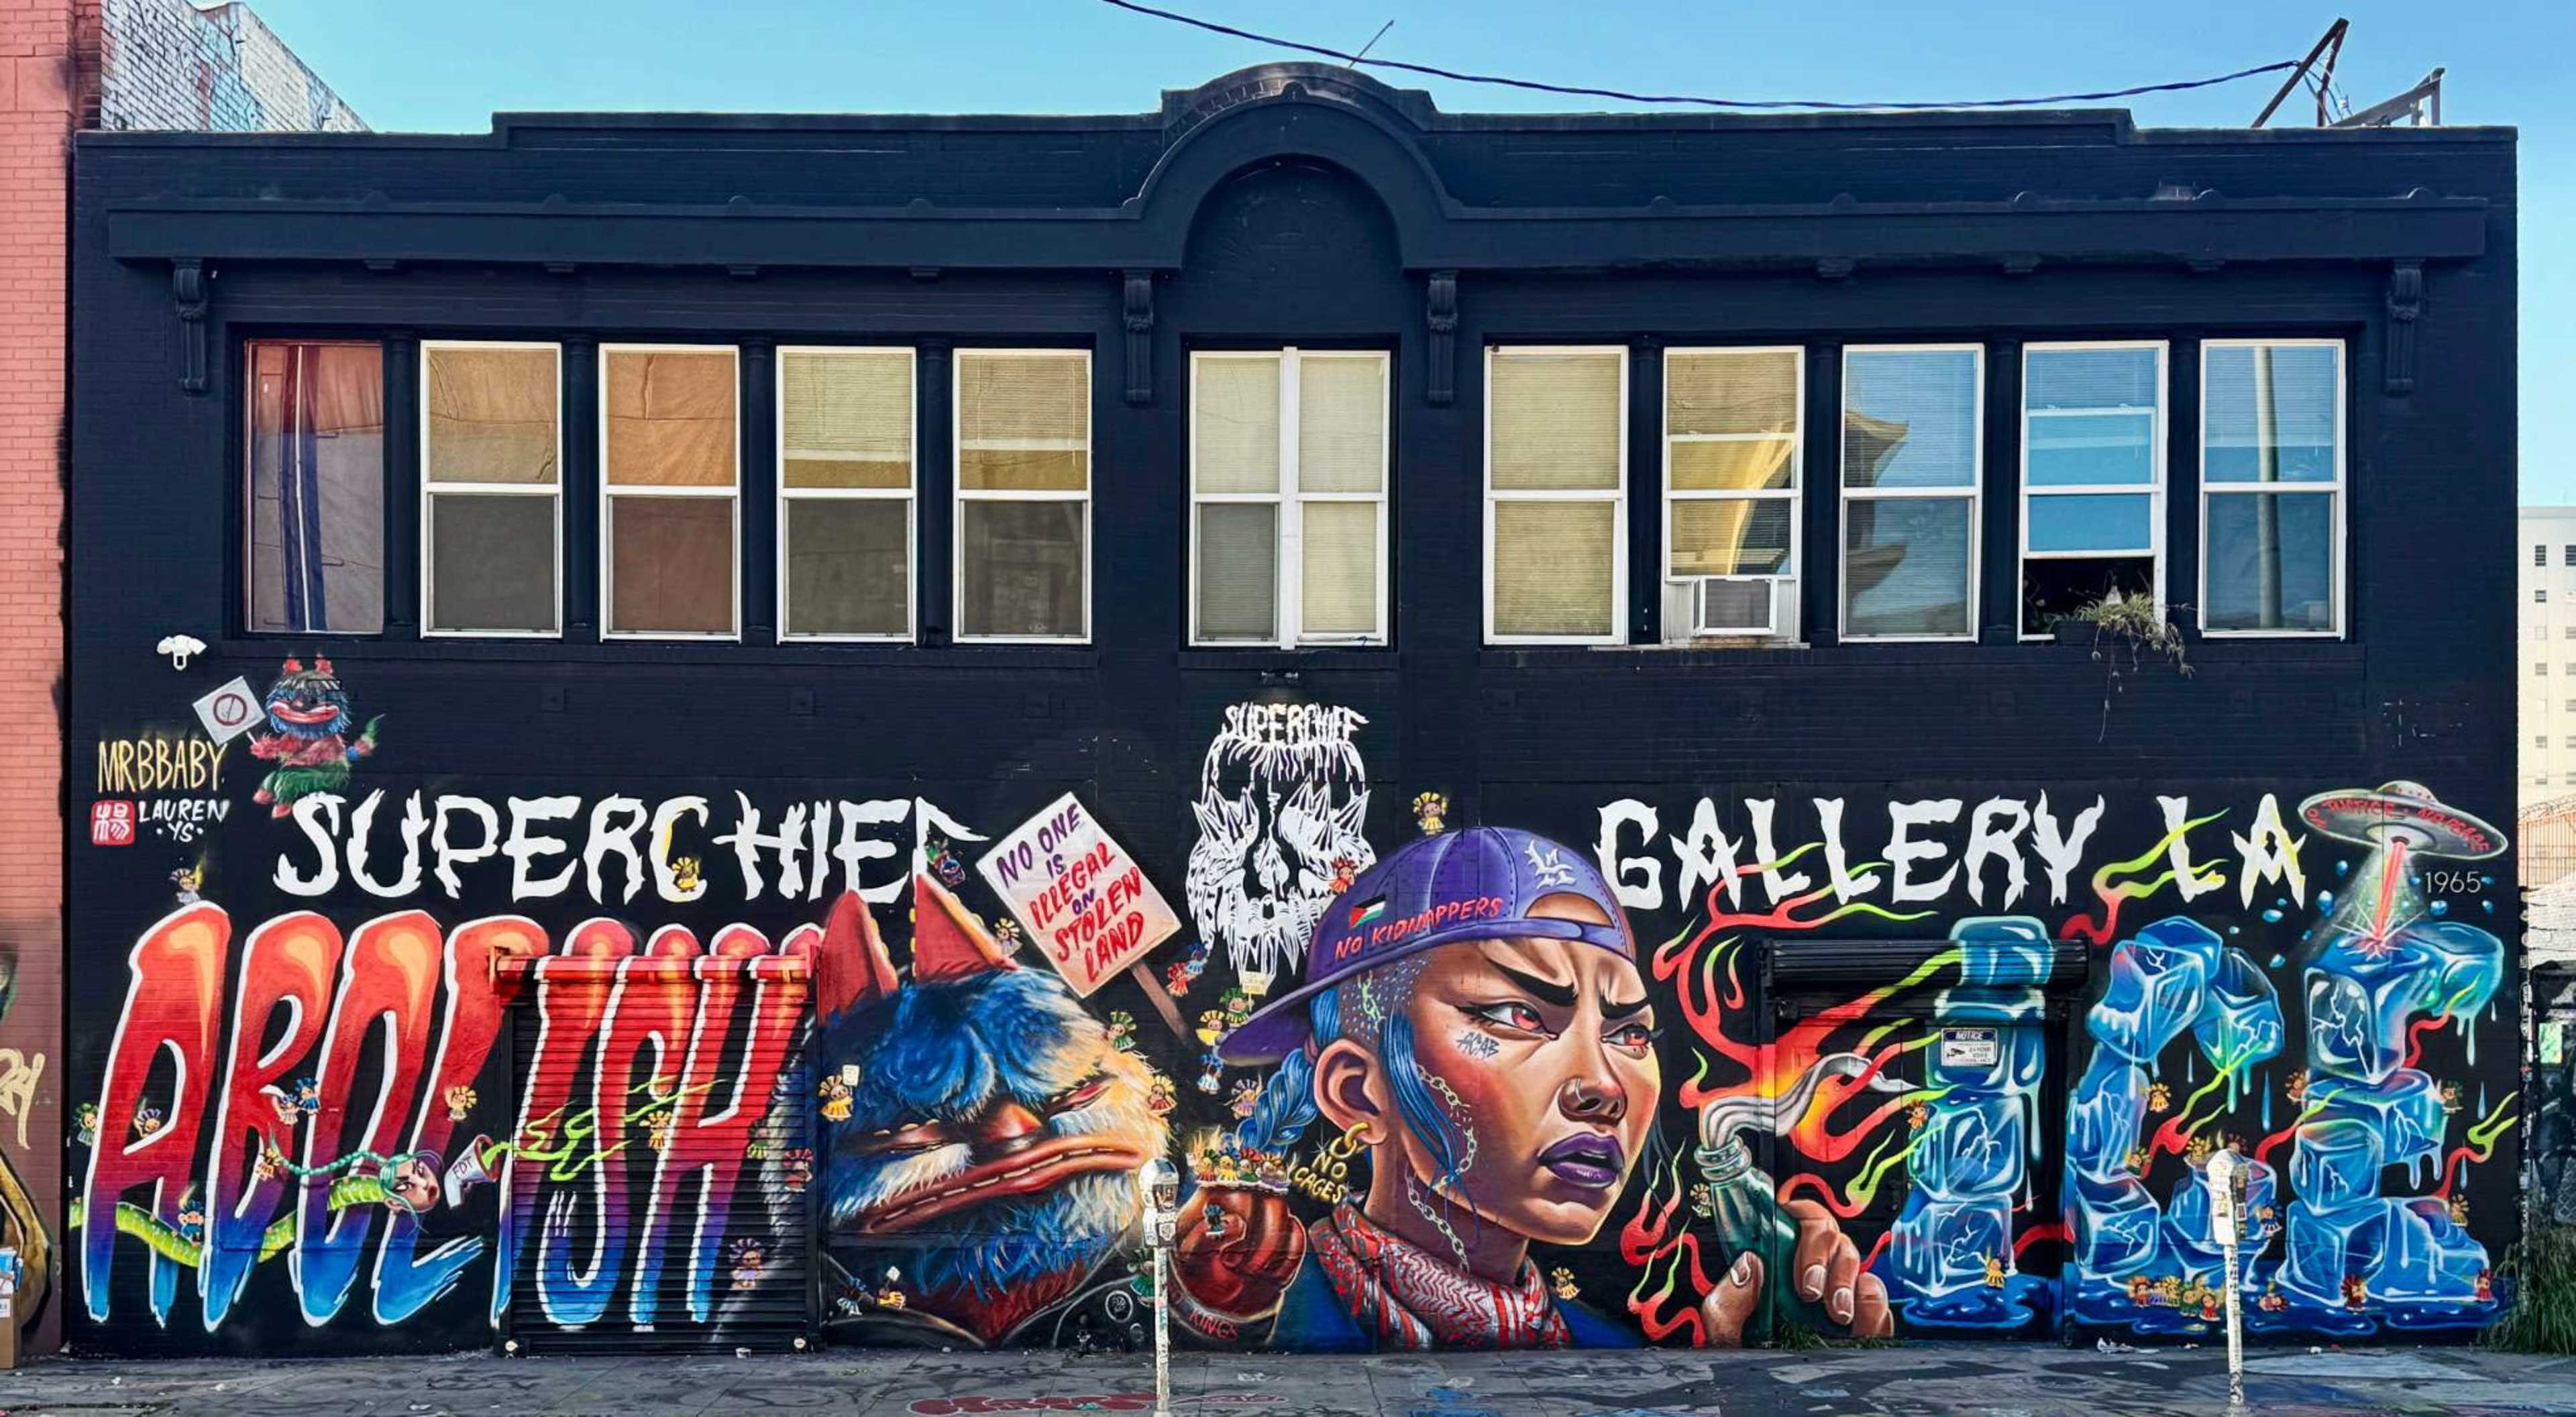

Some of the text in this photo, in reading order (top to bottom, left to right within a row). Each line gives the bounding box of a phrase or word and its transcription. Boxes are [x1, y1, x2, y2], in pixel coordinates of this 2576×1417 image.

[1222, 702, 1370, 744] SUPERCHIEF
[98, 739, 228, 793] MRBBABY
[138, 798, 231, 823] LAUREN
[272, 788, 2306, 912] SUPERCHIEF GALLERY LA
[996, 803, 1081, 889] NO ONE
[1046, 853, 1067, 878] IS
[1029, 841, 1116, 930] ILLEGAL
[1072, 888, 1095, 915] ON
[2424, 872, 2481, 893] 1965
[1055, 866, 1142, 962] STOLEN
[1334, 896, 1505, 959] NO KIDNAPPERS
[1085, 911, 1144, 982] LAND
[1456, 1033, 1499, 1057] ACAB
[1955, 1031, 1984, 1040] NOTICE
[83, 900, 825, 1334] ABOLISH
[1294, 1167, 1347, 1204] CAGES
[1311, 1151, 1348, 1179] NO
